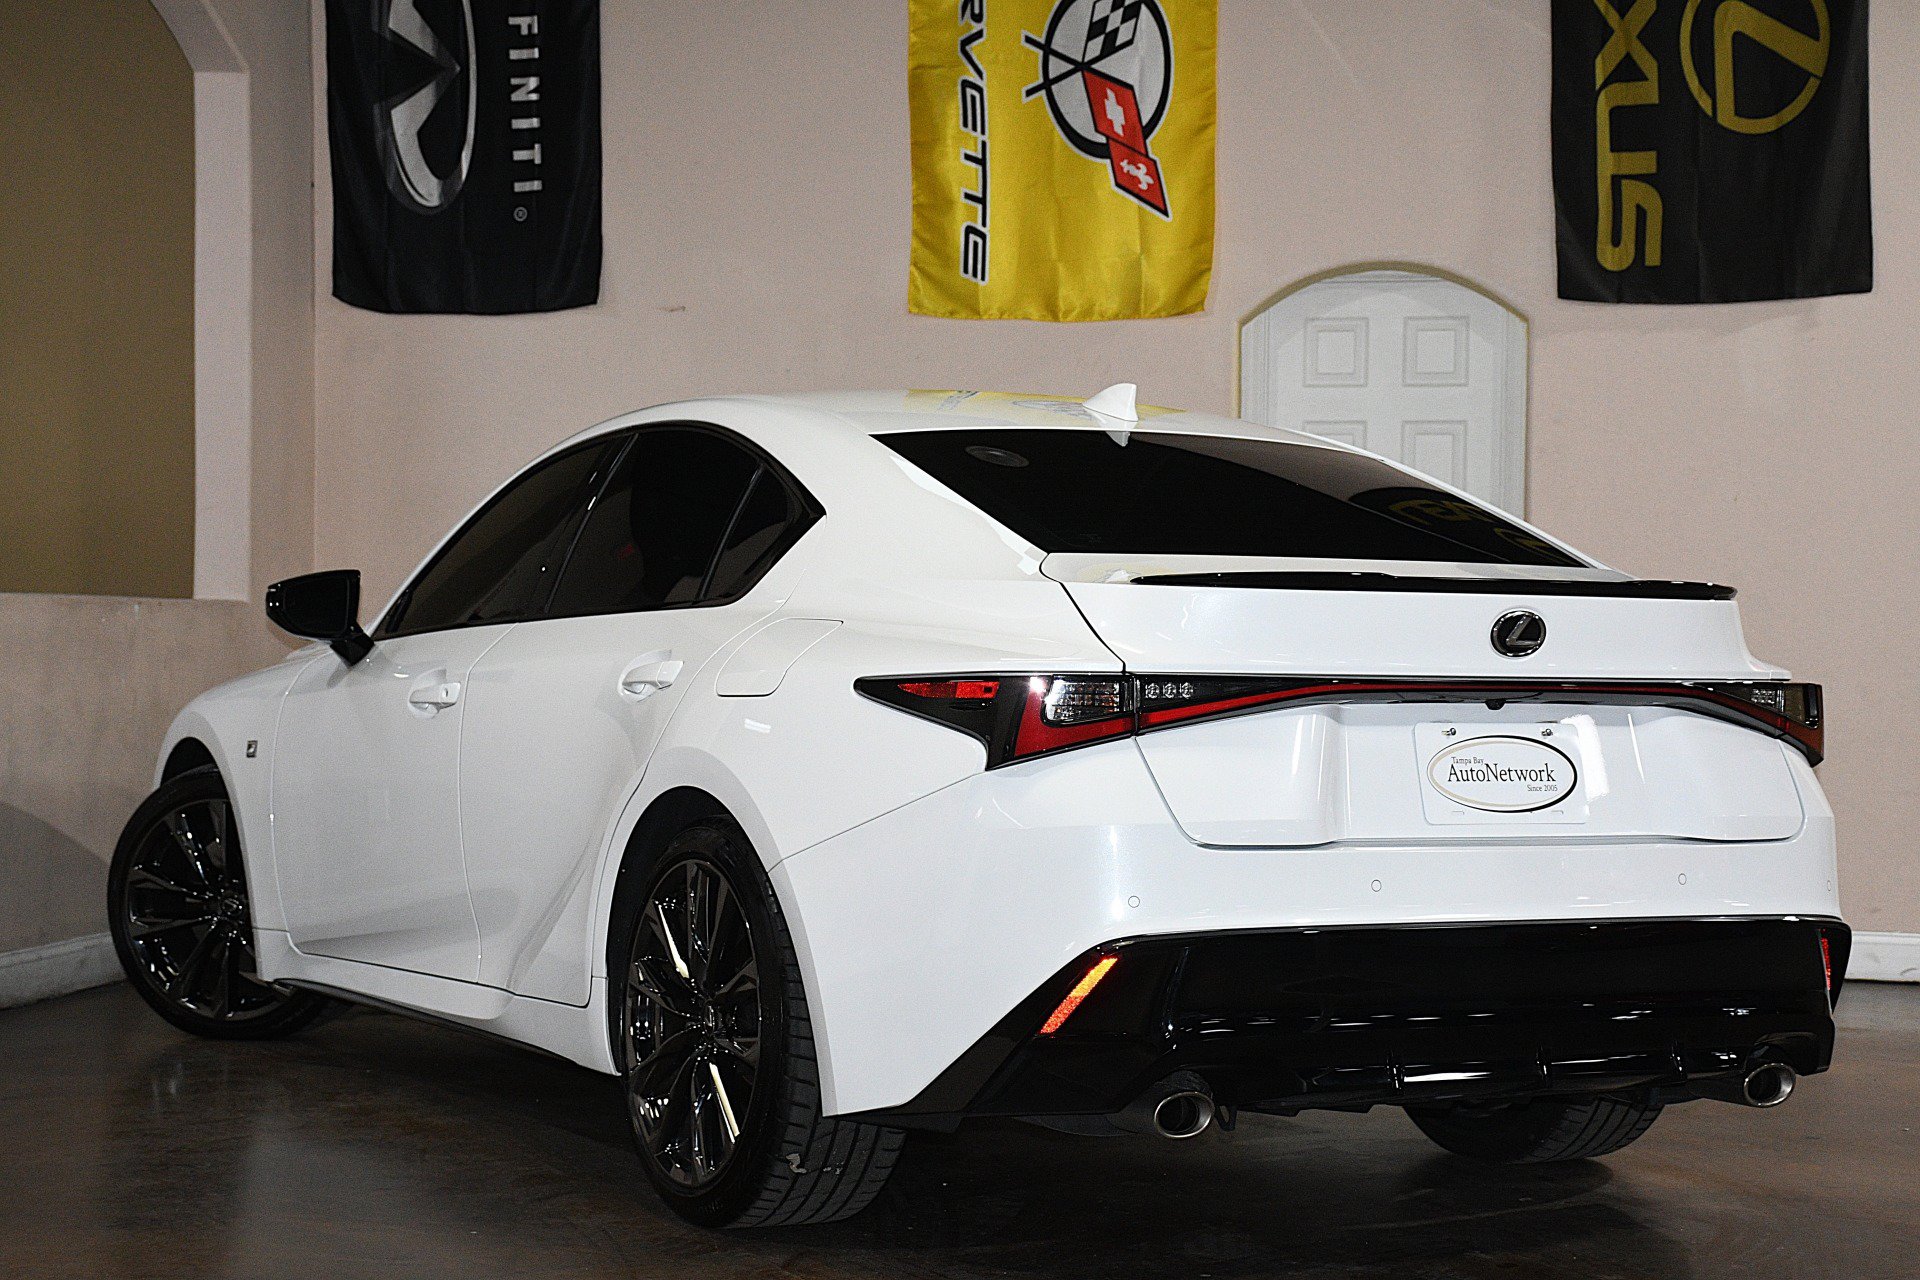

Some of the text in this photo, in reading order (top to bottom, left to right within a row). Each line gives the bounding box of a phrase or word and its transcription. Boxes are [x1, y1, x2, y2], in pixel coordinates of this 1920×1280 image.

[508, 14, 543, 193] FINITI
[1594, 0, 1663, 272] XUS
[1451, 756, 1484, 766] Tampa Bay
[1447, 763, 1557, 782] AutoNetwork
[1526, 784, 1543, 792] Since
